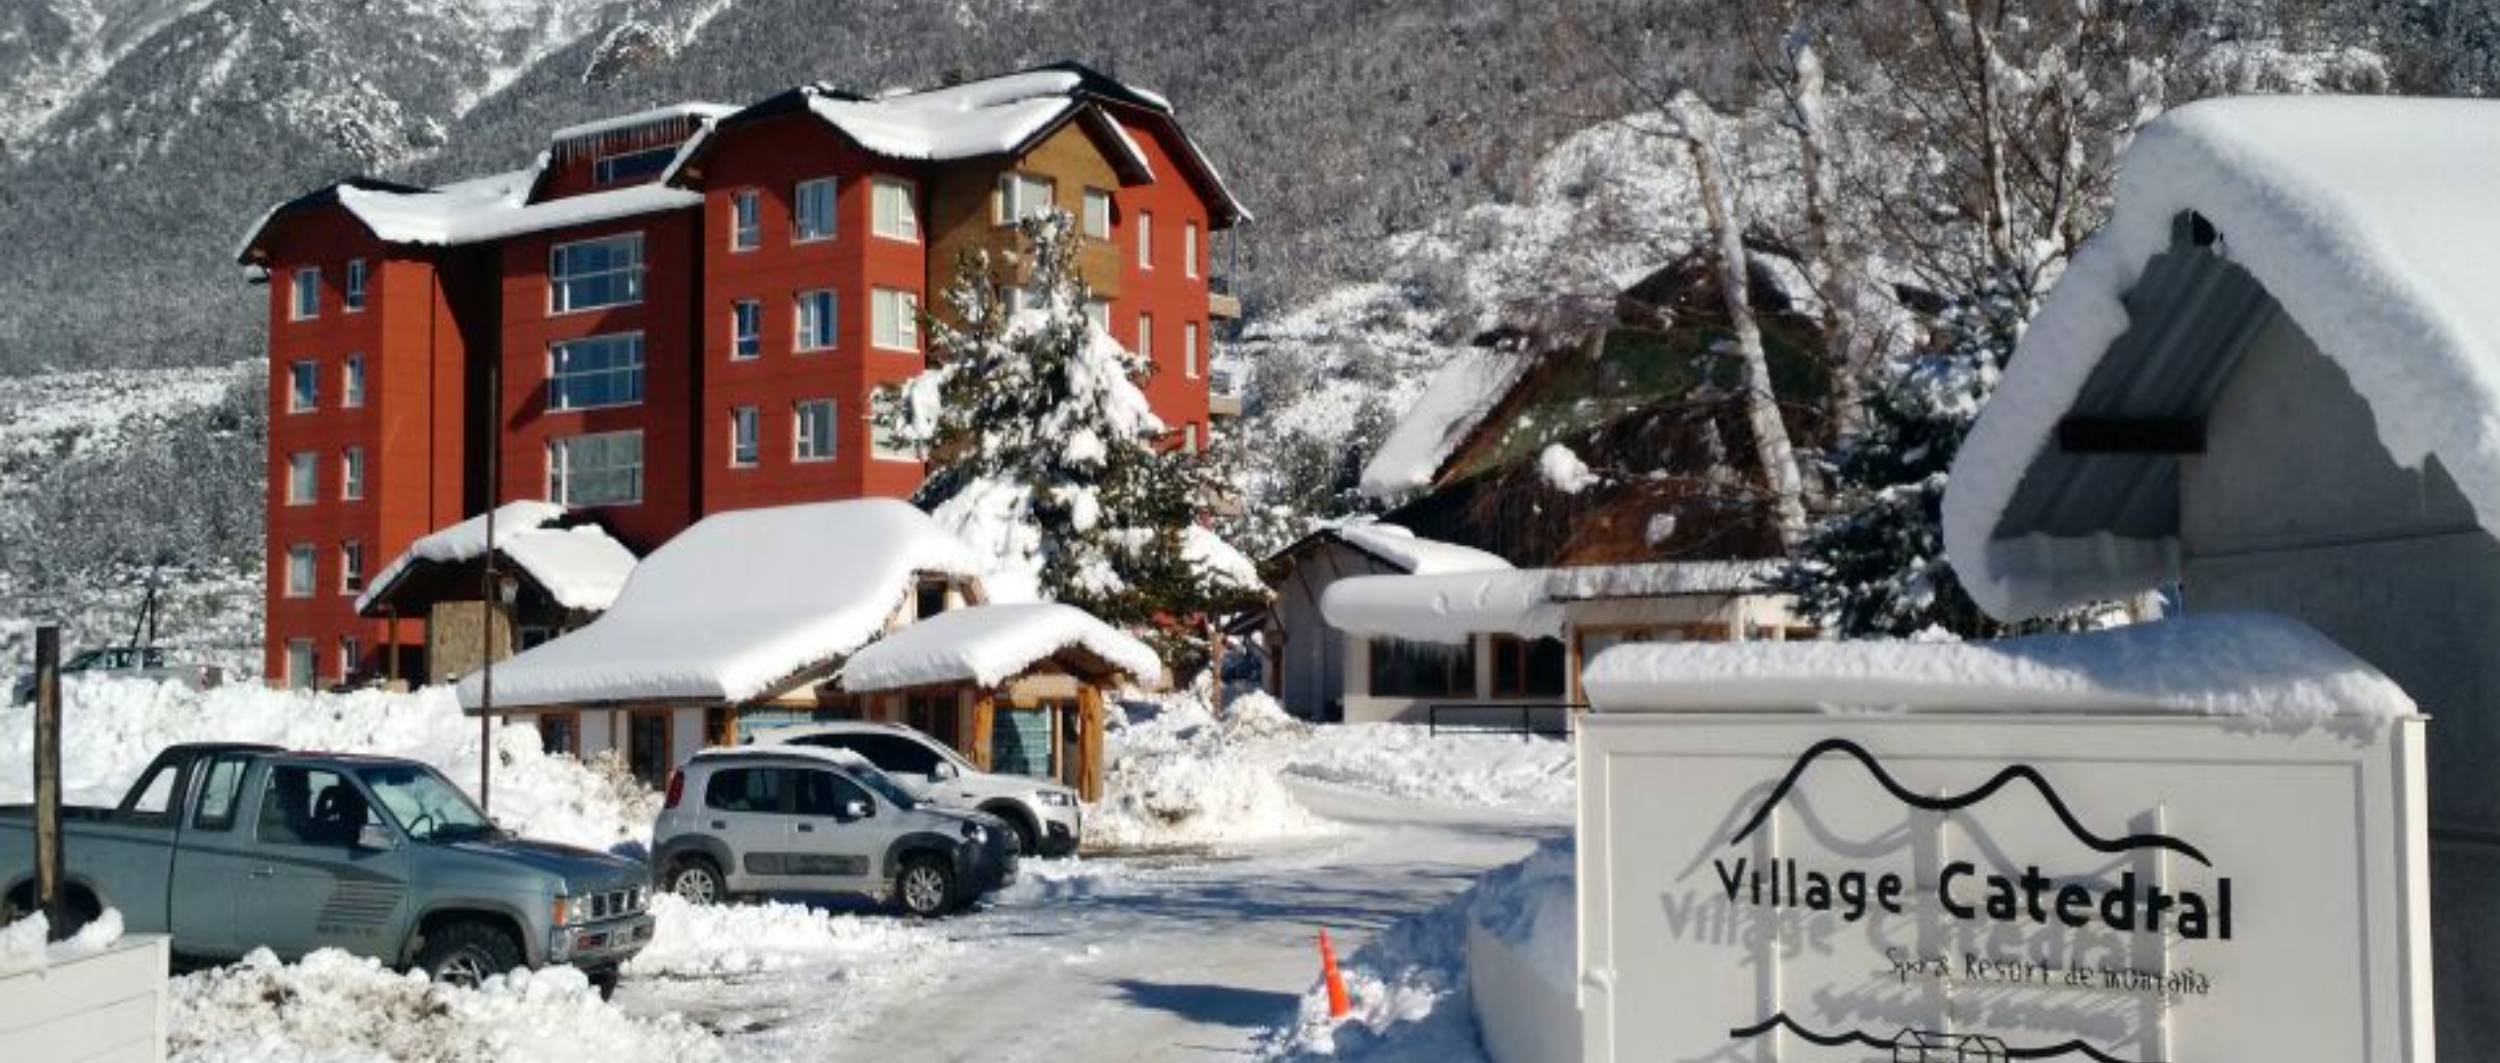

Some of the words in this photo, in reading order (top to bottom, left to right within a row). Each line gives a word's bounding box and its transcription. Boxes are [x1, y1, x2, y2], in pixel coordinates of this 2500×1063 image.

[1714, 857, 1903, 922] Village
[1939, 861, 2232, 940] Catedral
[1965, 952, 2049, 985] Resort
[2064, 960, 2094, 988] de
